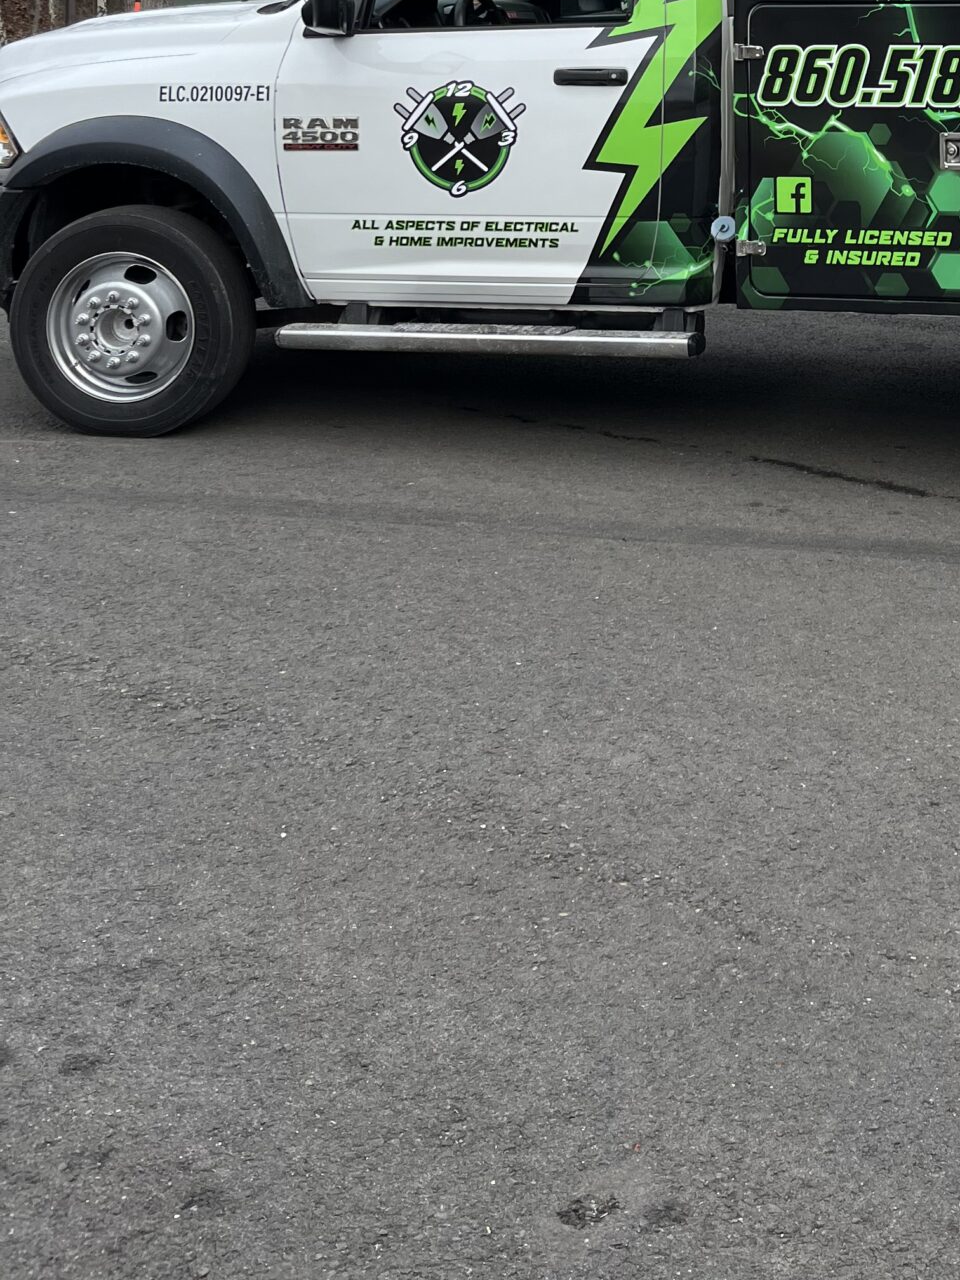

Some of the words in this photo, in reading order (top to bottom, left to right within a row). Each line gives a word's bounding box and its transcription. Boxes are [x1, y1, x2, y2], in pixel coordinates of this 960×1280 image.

[159, 85, 270, 102] ELC.0210097-E1
[446, 82, 473, 97] 12
[282, 117, 360, 130] RAM
[282, 131, 360, 144] 4500
[403, 132, 419, 148] 9
[498, 131, 515, 146] 3
[451, 180, 467, 195] 6
[351, 219, 379, 230] ALL
[384, 220, 456, 231] ASPECTS
[460, 221, 481, 231] OF
[484, 221, 579, 233] ELECTRICAL
[374, 236, 384, 247] &
[389, 236, 432, 247] HOME
[436, 237, 559, 248] IMPROVEMENTS
[772, 228, 839, 244] FULLY
[845, 229, 953, 247] LICENSED
[803, 250, 818, 265] &
[825, 250, 922, 267] INSURED
